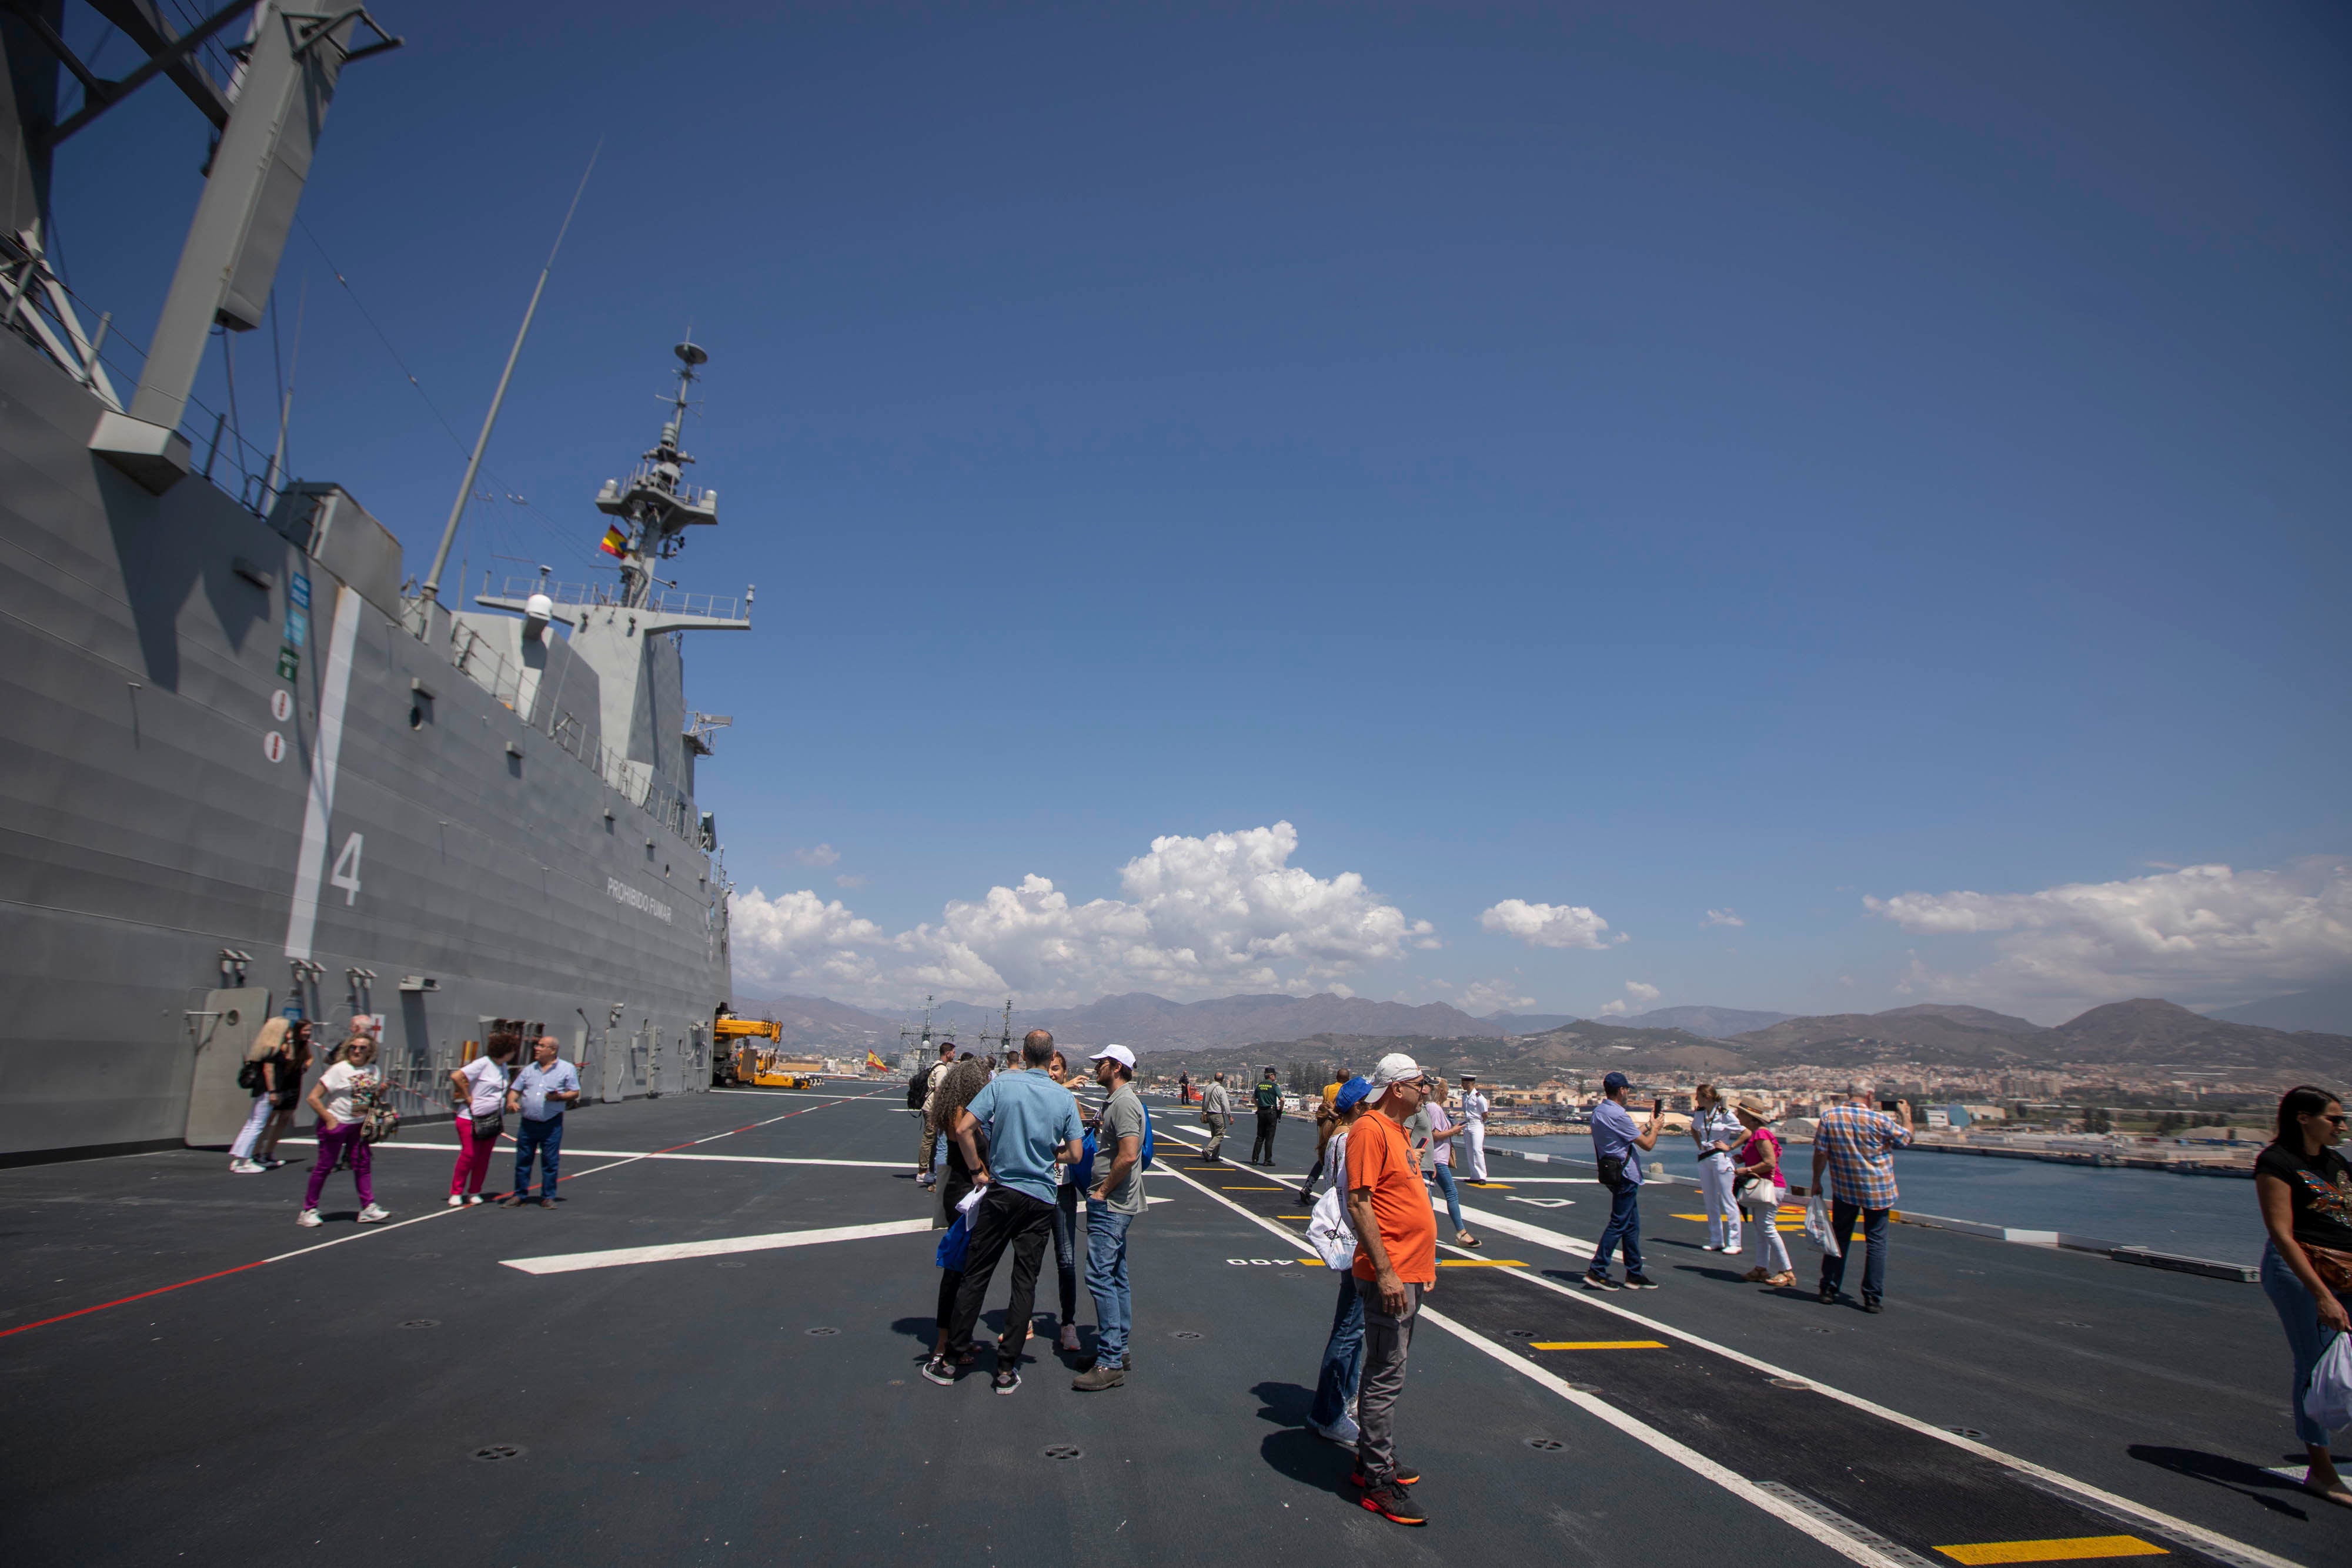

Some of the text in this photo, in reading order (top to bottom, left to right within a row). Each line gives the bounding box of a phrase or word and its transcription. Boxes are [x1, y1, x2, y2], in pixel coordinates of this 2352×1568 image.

[330, 832, 364, 906] 4
[607, 876, 671, 923] PROHIBIDO FUMAR
